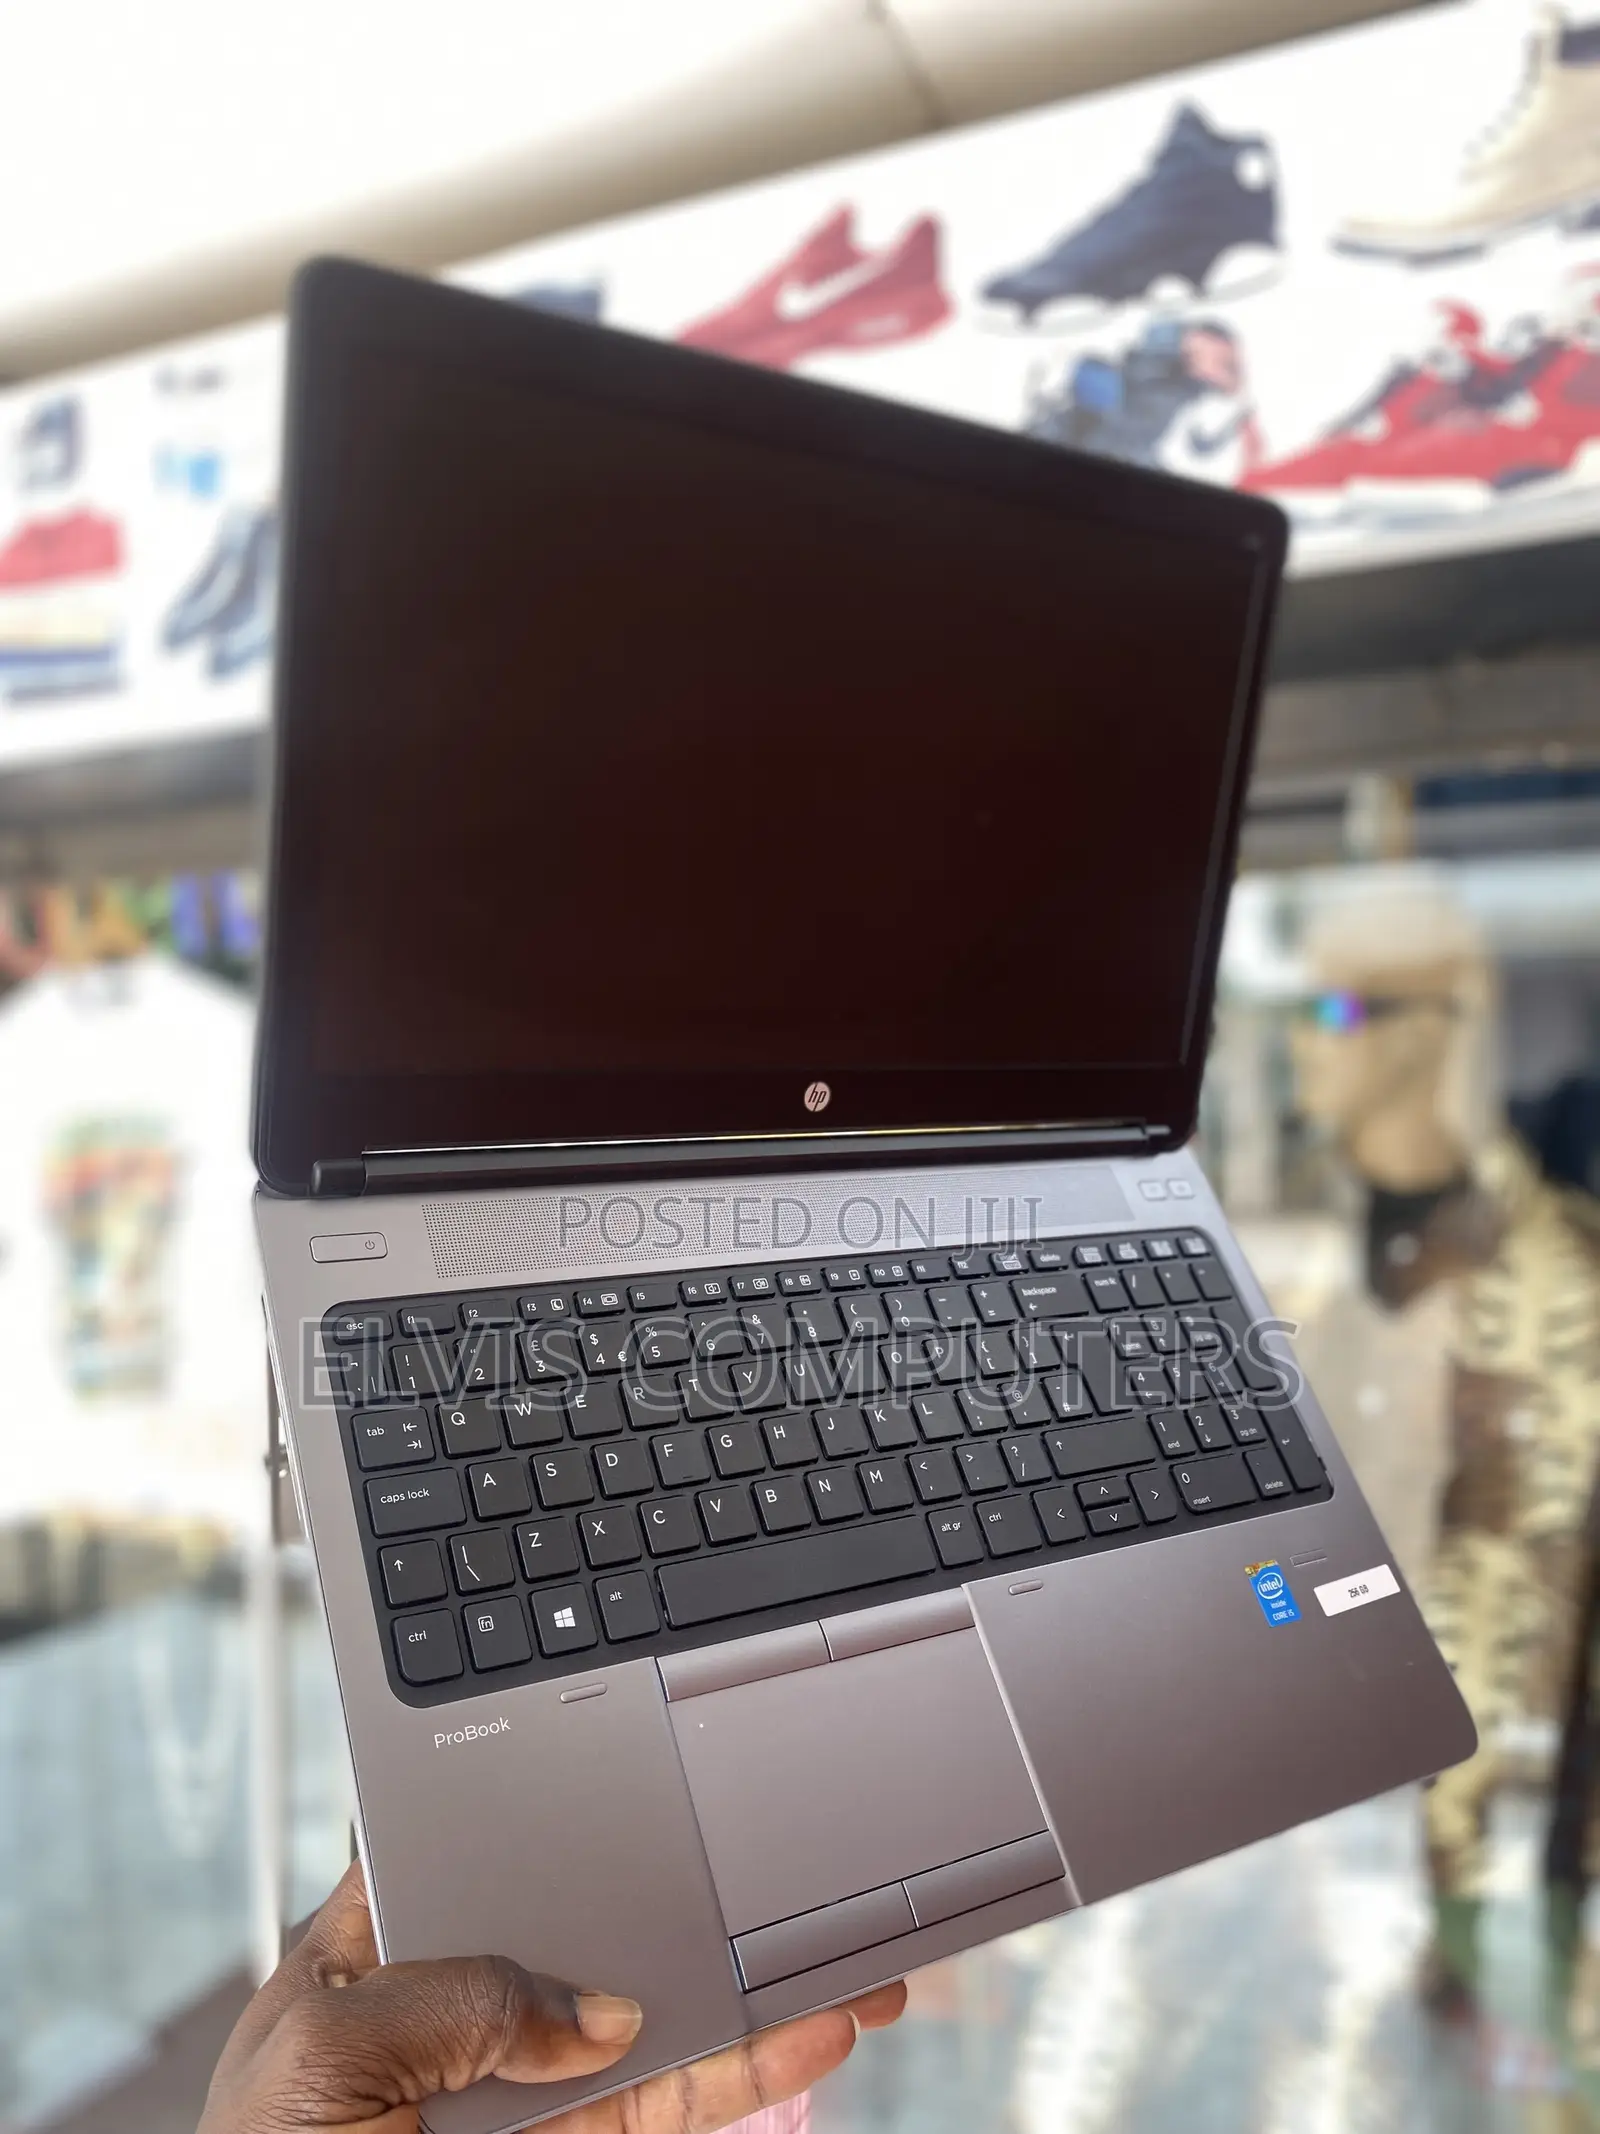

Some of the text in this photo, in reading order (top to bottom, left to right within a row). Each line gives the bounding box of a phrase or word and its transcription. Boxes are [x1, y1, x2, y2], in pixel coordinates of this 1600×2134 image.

[807, 1083, 827, 1112] hp
[346, 1321, 364, 1331] esc
[474, 1368, 486, 1381] 2
[688, 1378, 699, 1392] T
[633, 1387, 646, 1401] R
[575, 1394, 587, 1409] E
[514, 1402, 532, 1417] W
[874, 1409, 887, 1422] K
[450, 1411, 466, 1427] Q
[366, 1425, 385, 1437] tab
[773, 1425, 787, 1440] H
[719, 1434, 733, 1448] G
[663, 1444, 674, 1457] F
[606, 1453, 619, 1467] D
[546, 1463, 558, 1477] S
[869, 1470, 883, 1484] M
[483, 1473, 497, 1487] A
[818, 1479, 832, 1493] N
[380, 1488, 430, 1505] caps lock
[764, 1489, 777, 1503] B
[709, 1498, 722, 1513] V
[652, 1510, 666, 1524] C
[988, 1512, 1002, 1522] ctrl
[591, 1521, 606, 1536] X
[528, 1533, 542, 1547] Z
[1259, 1576, 1282, 1593] intel
[609, 1590, 623, 1601] alt
[1347, 1586, 1360, 1599] 256
[1270, 1599, 1287, 1609] inside
[1272, 1610, 1289, 1621] CORE
[408, 1630, 428, 1643] ctrl
[433, 1716, 511, 1749] ProBook
